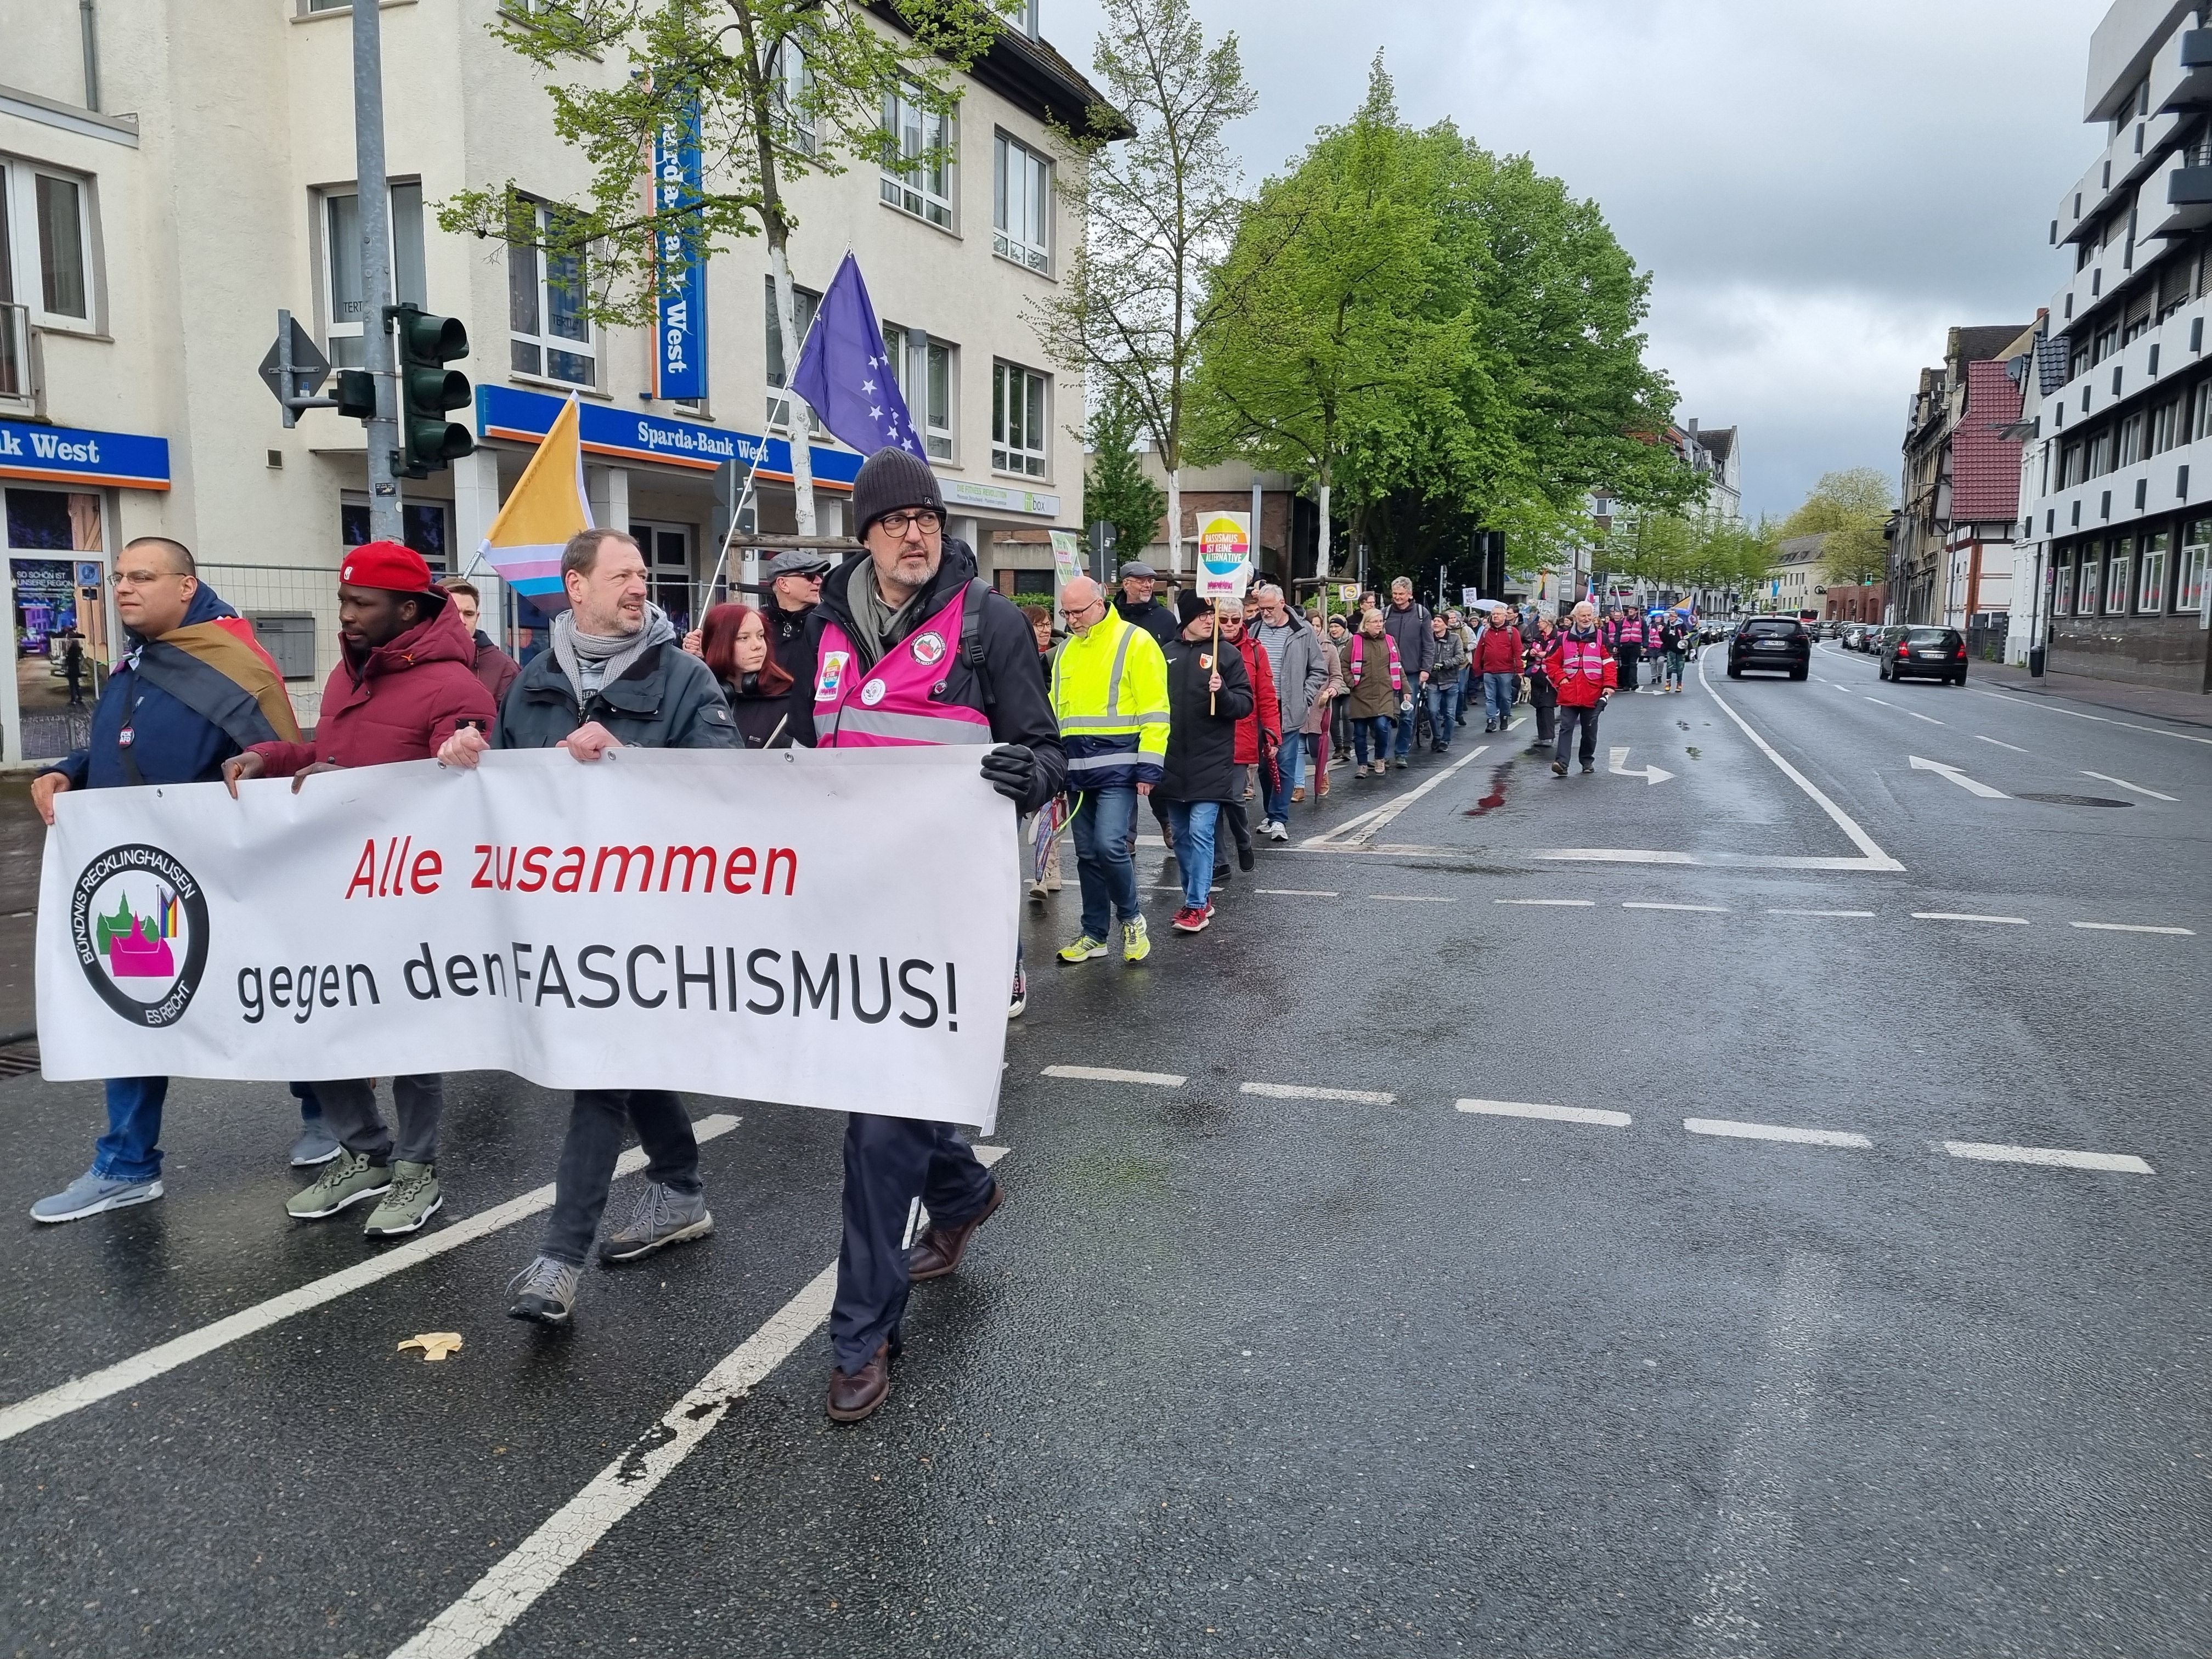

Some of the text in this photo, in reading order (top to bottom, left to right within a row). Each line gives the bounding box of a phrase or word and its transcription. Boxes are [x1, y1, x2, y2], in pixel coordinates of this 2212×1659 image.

[667, 301, 687, 374] West
[29, 432, 100, 464] West
[637, 421, 769, 462] Sparda-Bank West
[1205, 533, 1238, 543] RASSISMUS
[1215, 544, 1232, 552] KEINE
[29, 571, 54, 579] SCHÖN
[1205, 552, 1242, 562] ALTERNATIVE
[47, 579, 74, 587] REGION
[346, 836, 798, 899] Alle zusammen
[74, 849, 195, 965] BÜNDNIS RECKLINGHAUSEN
[145, 979, 190, 1025] ES REICHT
[238, 963, 380, 1024] gegen
